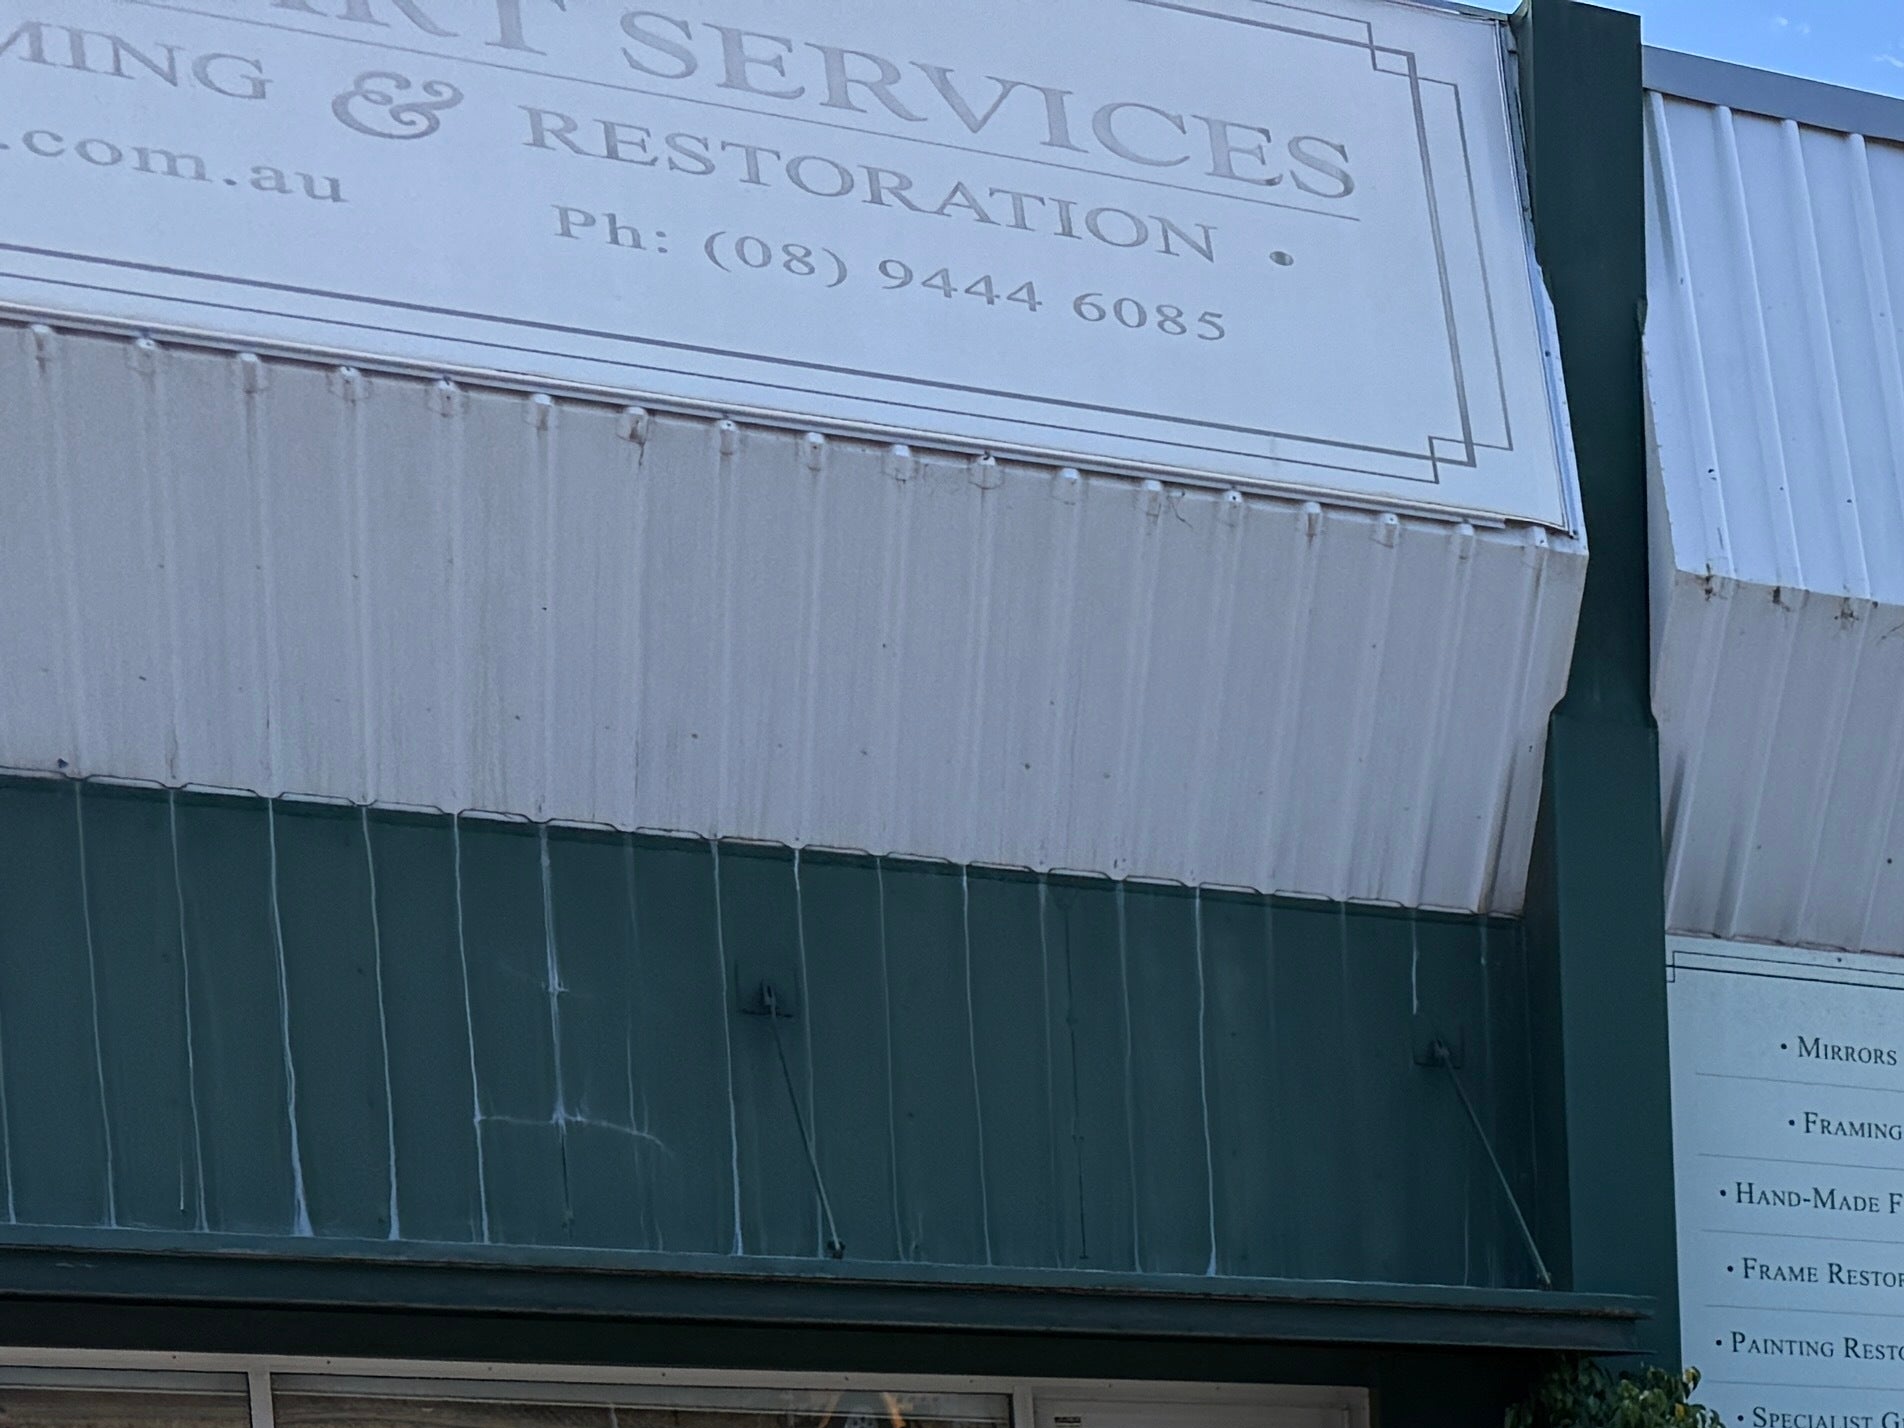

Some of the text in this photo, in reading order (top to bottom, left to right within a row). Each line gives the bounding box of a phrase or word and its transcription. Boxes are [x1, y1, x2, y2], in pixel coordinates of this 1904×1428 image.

[332, 71, 463, 140] &
[516, 104, 1220, 264] RESTORATION
[619, 9, 1355, 199] SERVICES
[551, 204, 1226, 342] Ph: (08) 9444 6085
